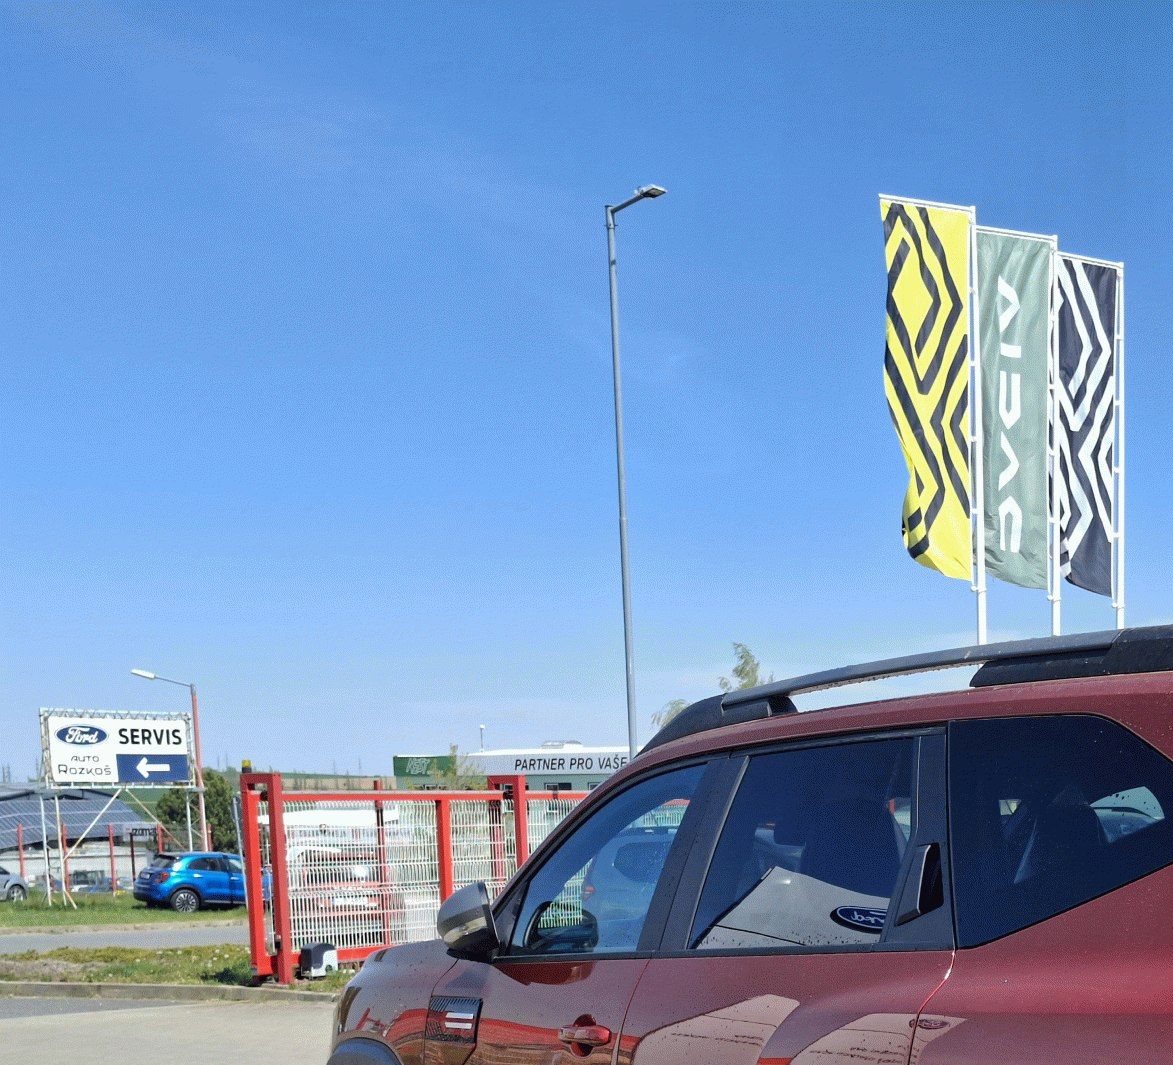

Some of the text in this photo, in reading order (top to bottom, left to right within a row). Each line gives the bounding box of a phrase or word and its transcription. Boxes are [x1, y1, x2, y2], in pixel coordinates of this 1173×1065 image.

[998, 275, 1023, 553] DACIA
[65, 726, 99, 743] Ford
[118, 728, 182, 745] SERVIS
[514, 758, 566, 771] PARTNER
[569, 757, 594, 770] PRO
